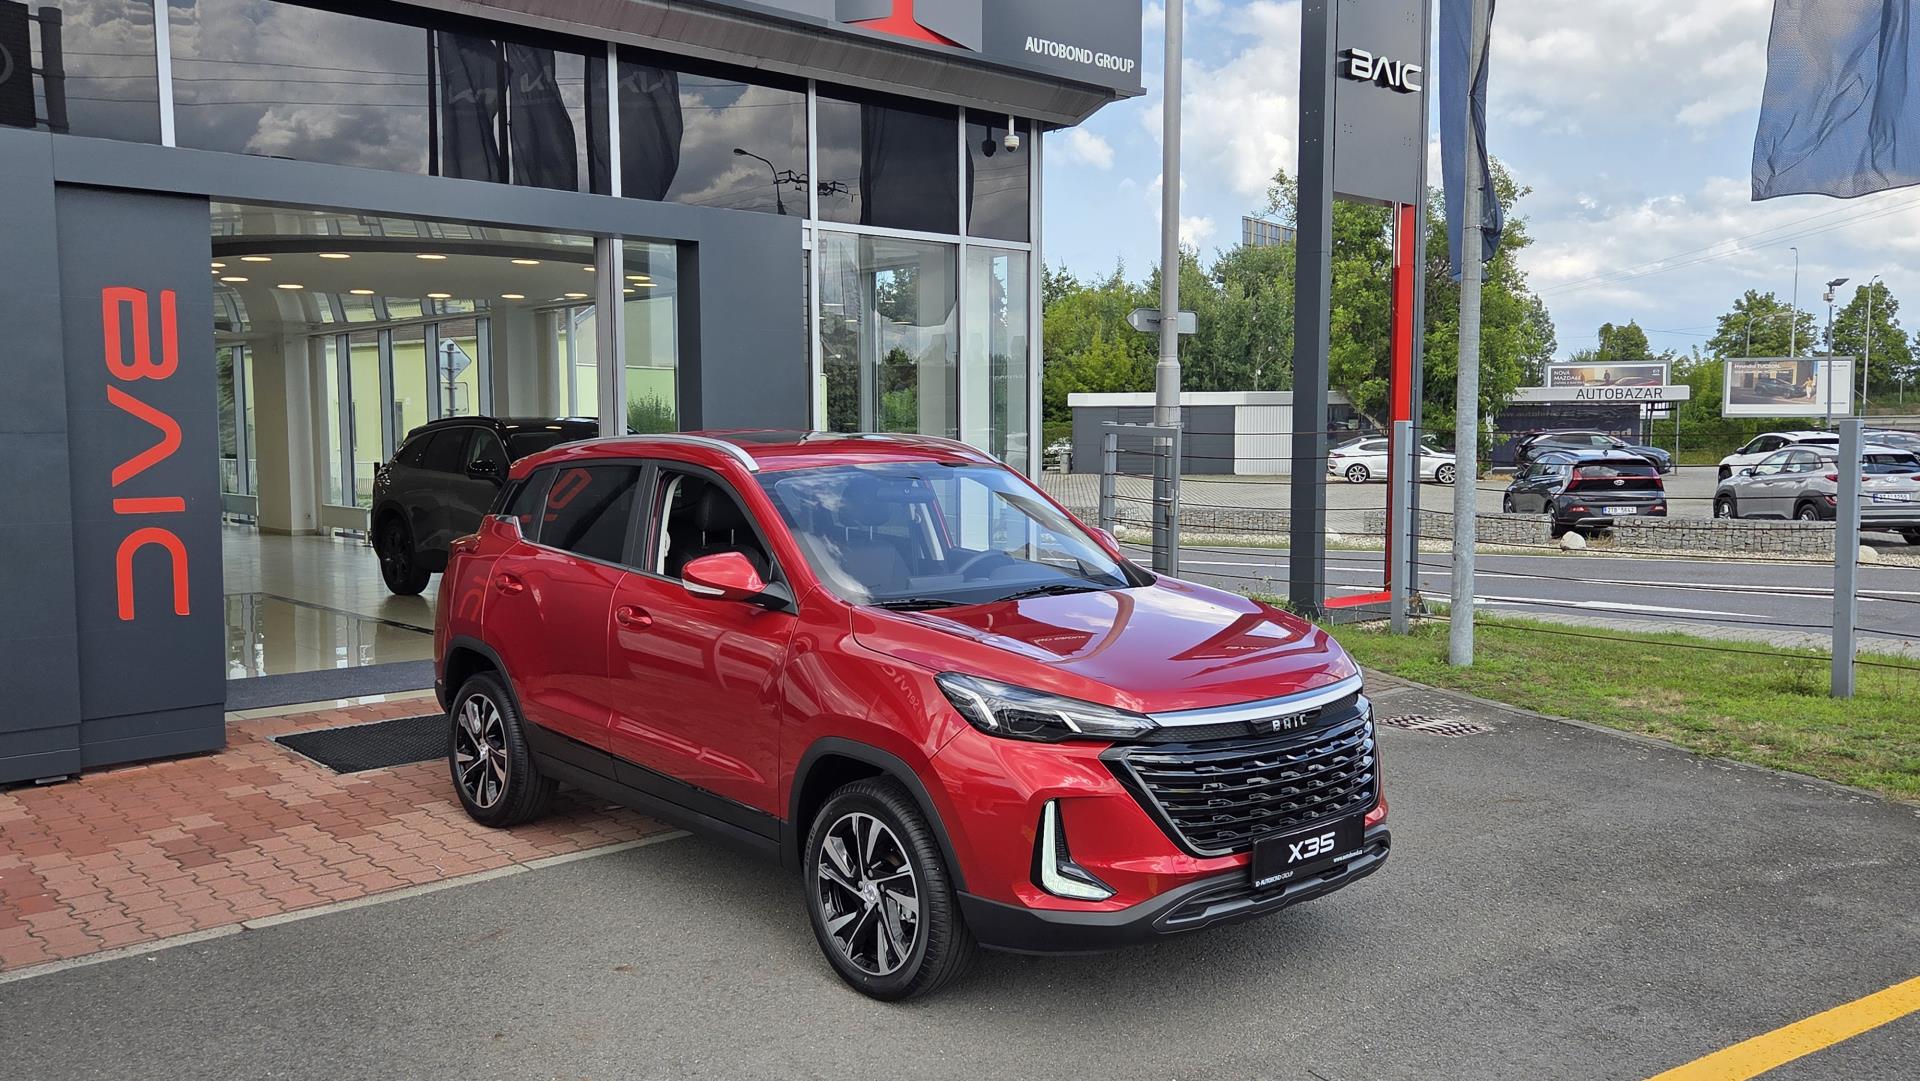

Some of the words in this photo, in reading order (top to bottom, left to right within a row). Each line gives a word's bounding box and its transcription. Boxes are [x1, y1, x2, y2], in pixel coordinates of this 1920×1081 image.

[1024, 36, 1093, 64] AUTOBOND
[1094, 52, 1135, 73] GROUP
[1351, 47, 1422, 92] BAIC
[1576, 388, 1663, 400] AUTOBAZAR
[102, 286, 190, 621] BAIC
[1272, 714, 1307, 732] BAIC
[1287, 831, 1336, 864] X35
